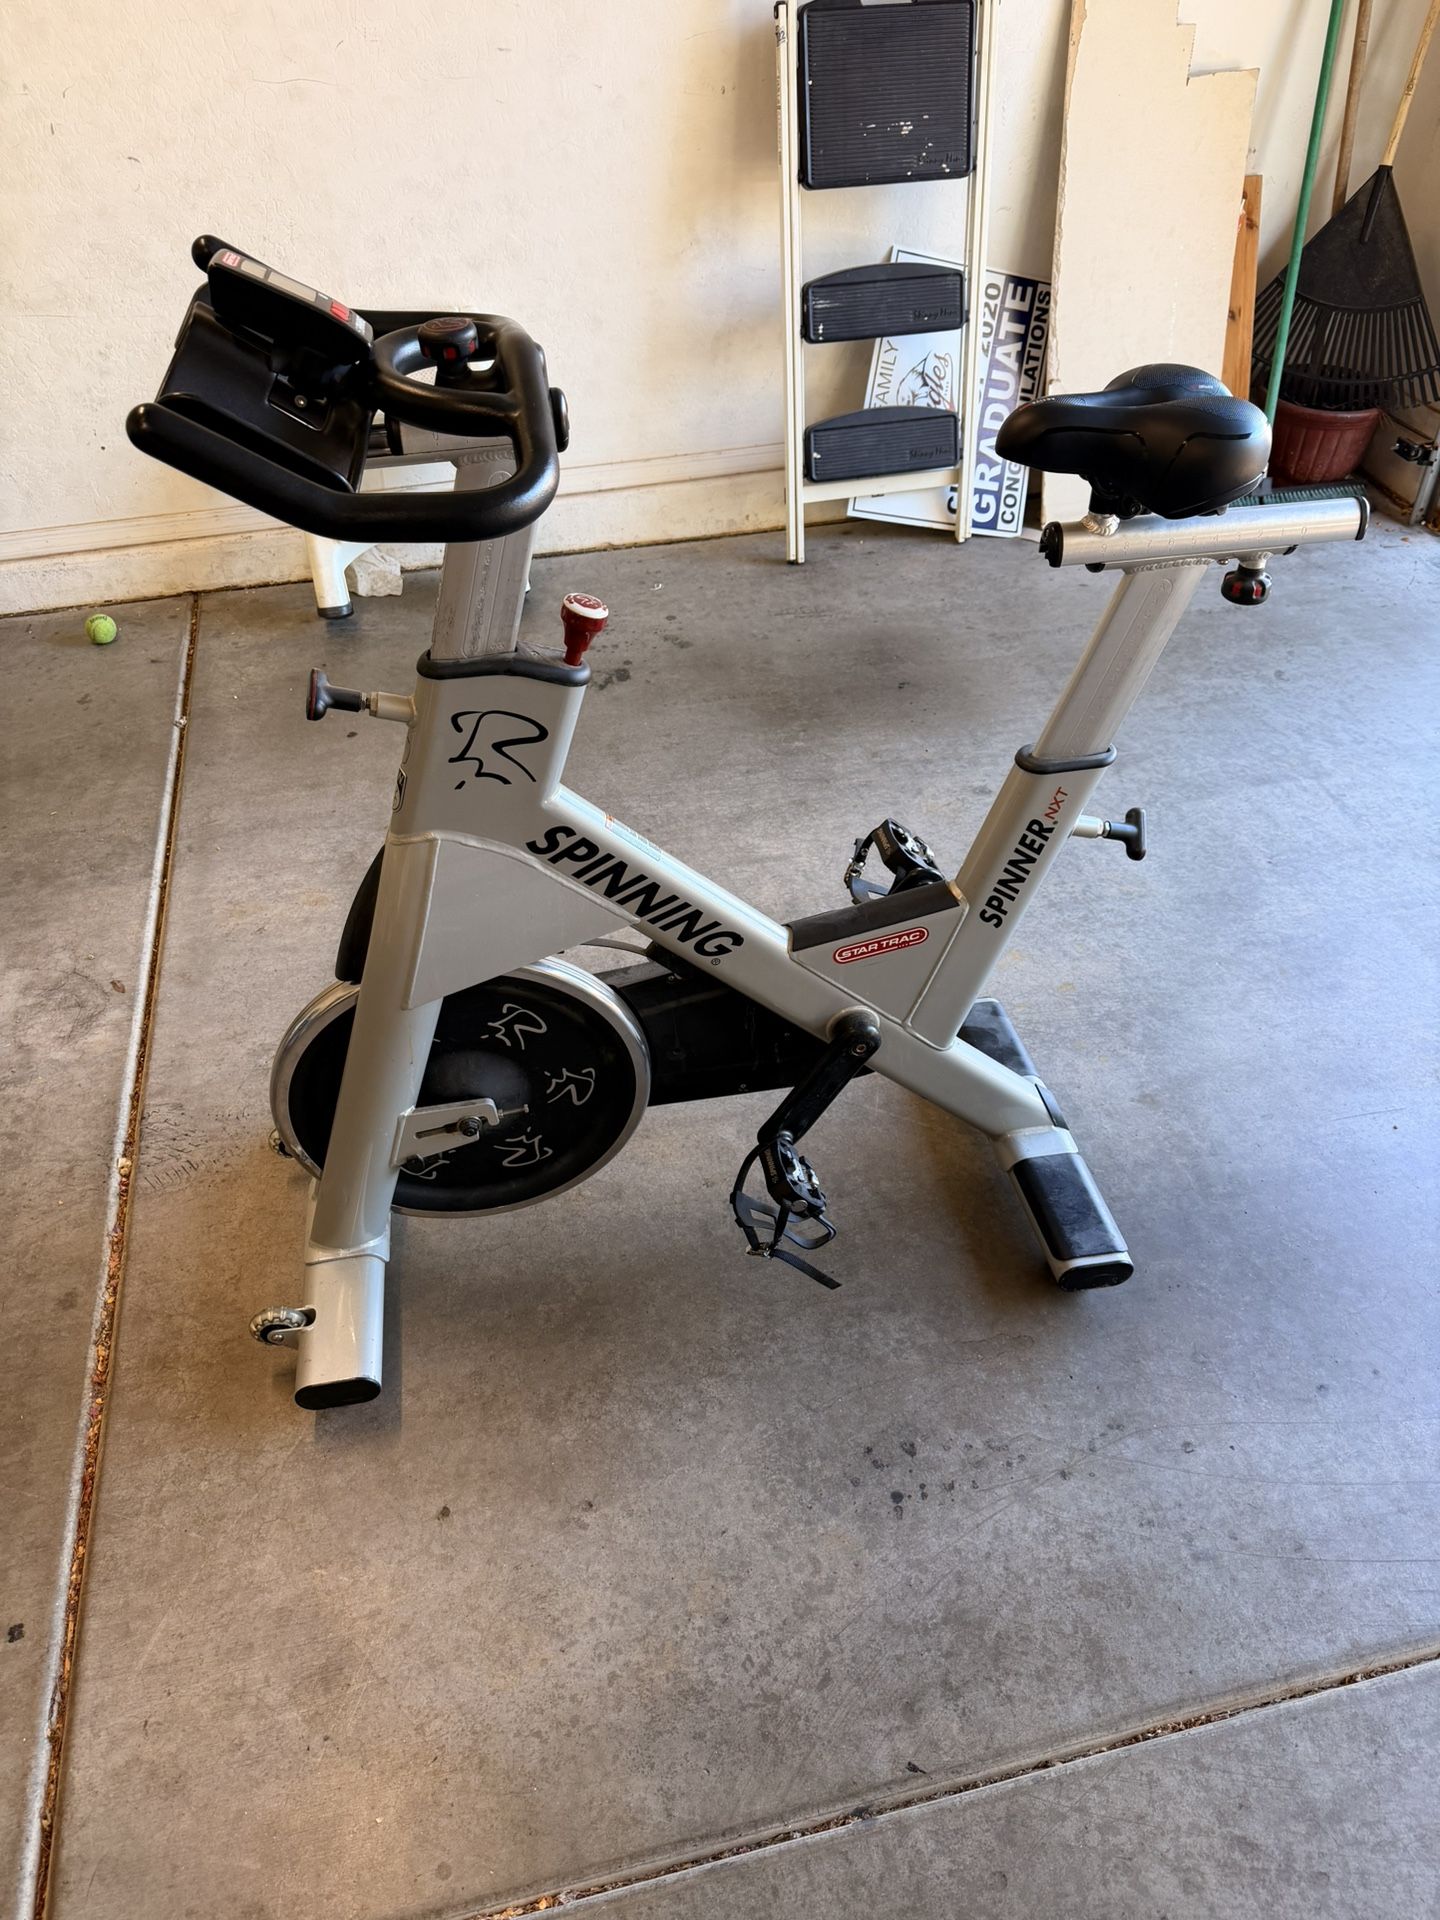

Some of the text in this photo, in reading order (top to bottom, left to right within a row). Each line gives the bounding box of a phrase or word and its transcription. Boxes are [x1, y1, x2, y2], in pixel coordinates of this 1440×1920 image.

[873, 340, 899, 408] AMILY
[972, 282, 1034, 524] GRADUATE
[525, 825, 745, 957] SPINNING
[979, 786, 1069, 929] SPINNER NXT
[841, 932, 921, 959] STAR TRAC
